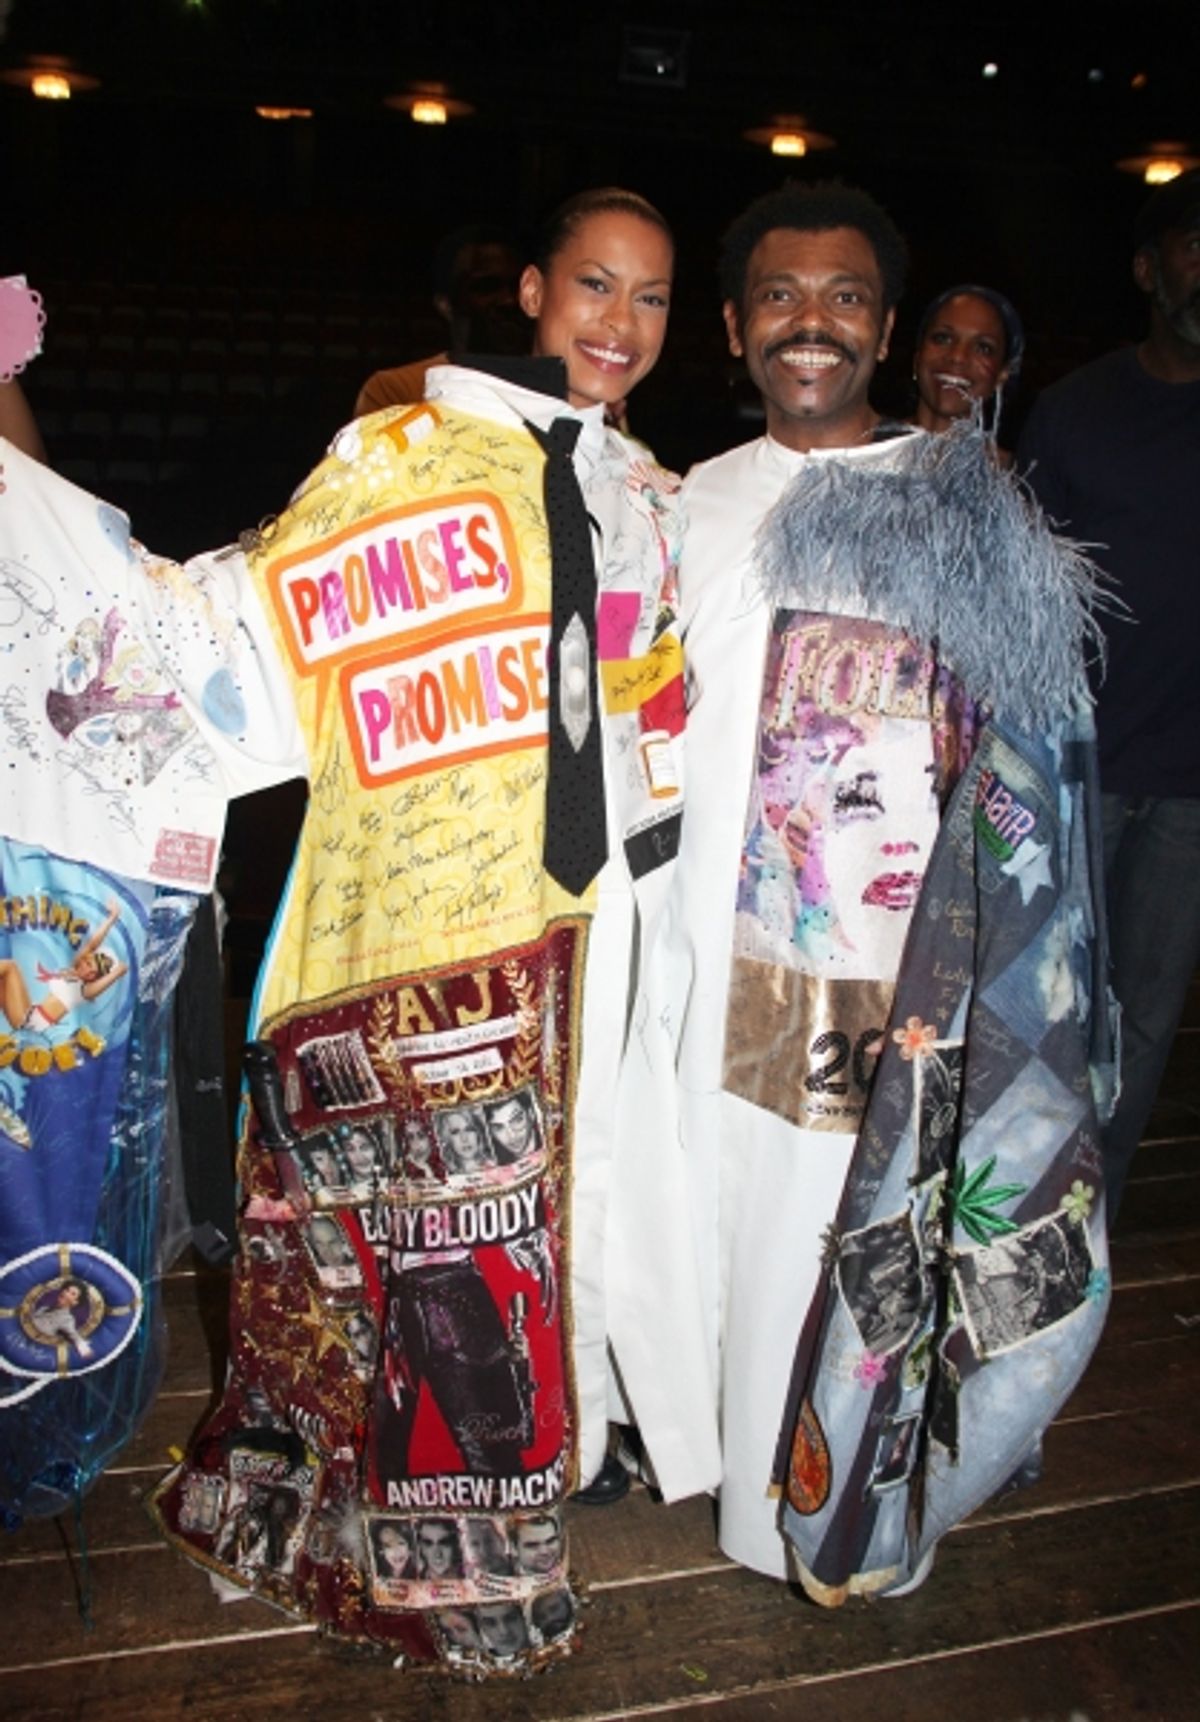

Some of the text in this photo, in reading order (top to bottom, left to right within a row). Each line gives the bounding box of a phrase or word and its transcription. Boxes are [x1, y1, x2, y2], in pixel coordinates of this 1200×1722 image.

[288, 514, 509, 646] PROMISES,
[358, 638, 550, 762] PROMISE
[422, 1186, 543, 1248] BLOODY
[386, 1475, 493, 1508] ANDREW
